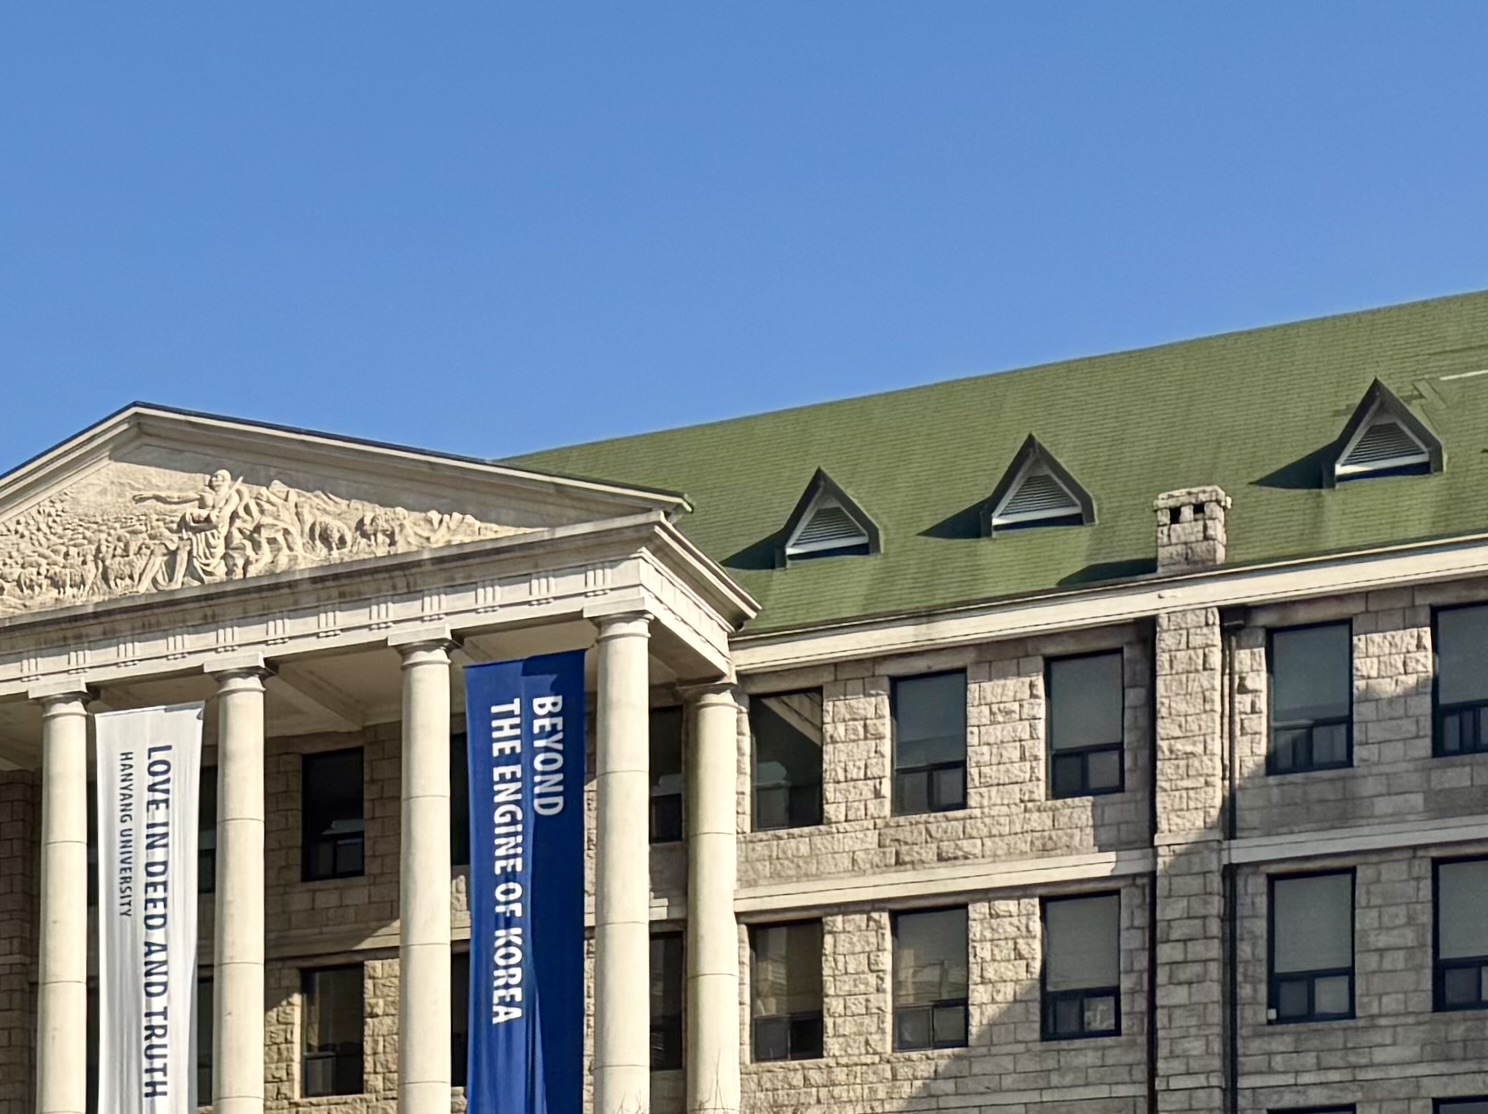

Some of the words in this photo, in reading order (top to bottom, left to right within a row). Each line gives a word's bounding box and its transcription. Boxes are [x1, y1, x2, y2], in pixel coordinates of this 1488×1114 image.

[490, 698, 522, 758] THE
[532, 695, 564, 816] BEYOND
[119, 751, 134, 824] HANYANG
[146, 744, 173, 813] LOVE
[145, 821, 170, 850] IN
[492, 764, 524, 875] ENGINE
[118, 828, 133, 917] UNIVERSITY
[144, 860, 169, 931] DEED
[494, 881, 523, 918] OF
[144, 940, 169, 998] AND
[492, 927, 523, 1025] KOREA
[144, 1006, 169, 1099] TRUTH
